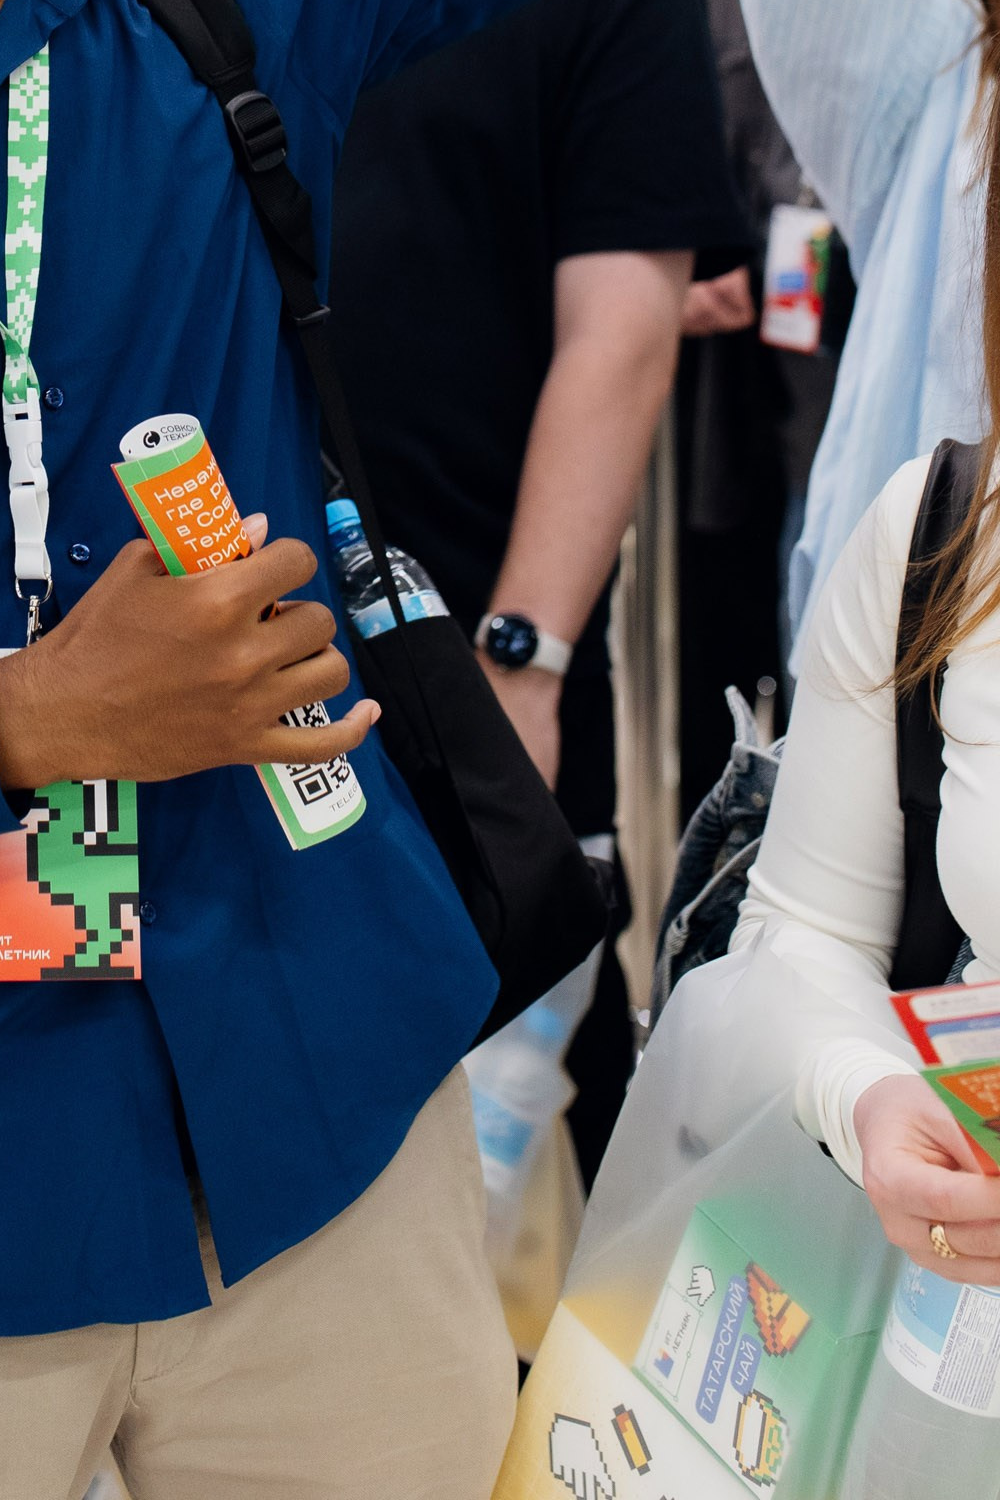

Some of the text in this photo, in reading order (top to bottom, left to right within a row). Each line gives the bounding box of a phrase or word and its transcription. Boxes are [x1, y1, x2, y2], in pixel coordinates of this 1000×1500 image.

[166, 497, 204, 521] где
[176, 492, 231, 537] в Сов
[184, 509, 240, 552] Техно
[700, 1282, 745, 1412] ТАТАРСКИЙ
[735, 1340, 757, 1386] ЧАЙ
